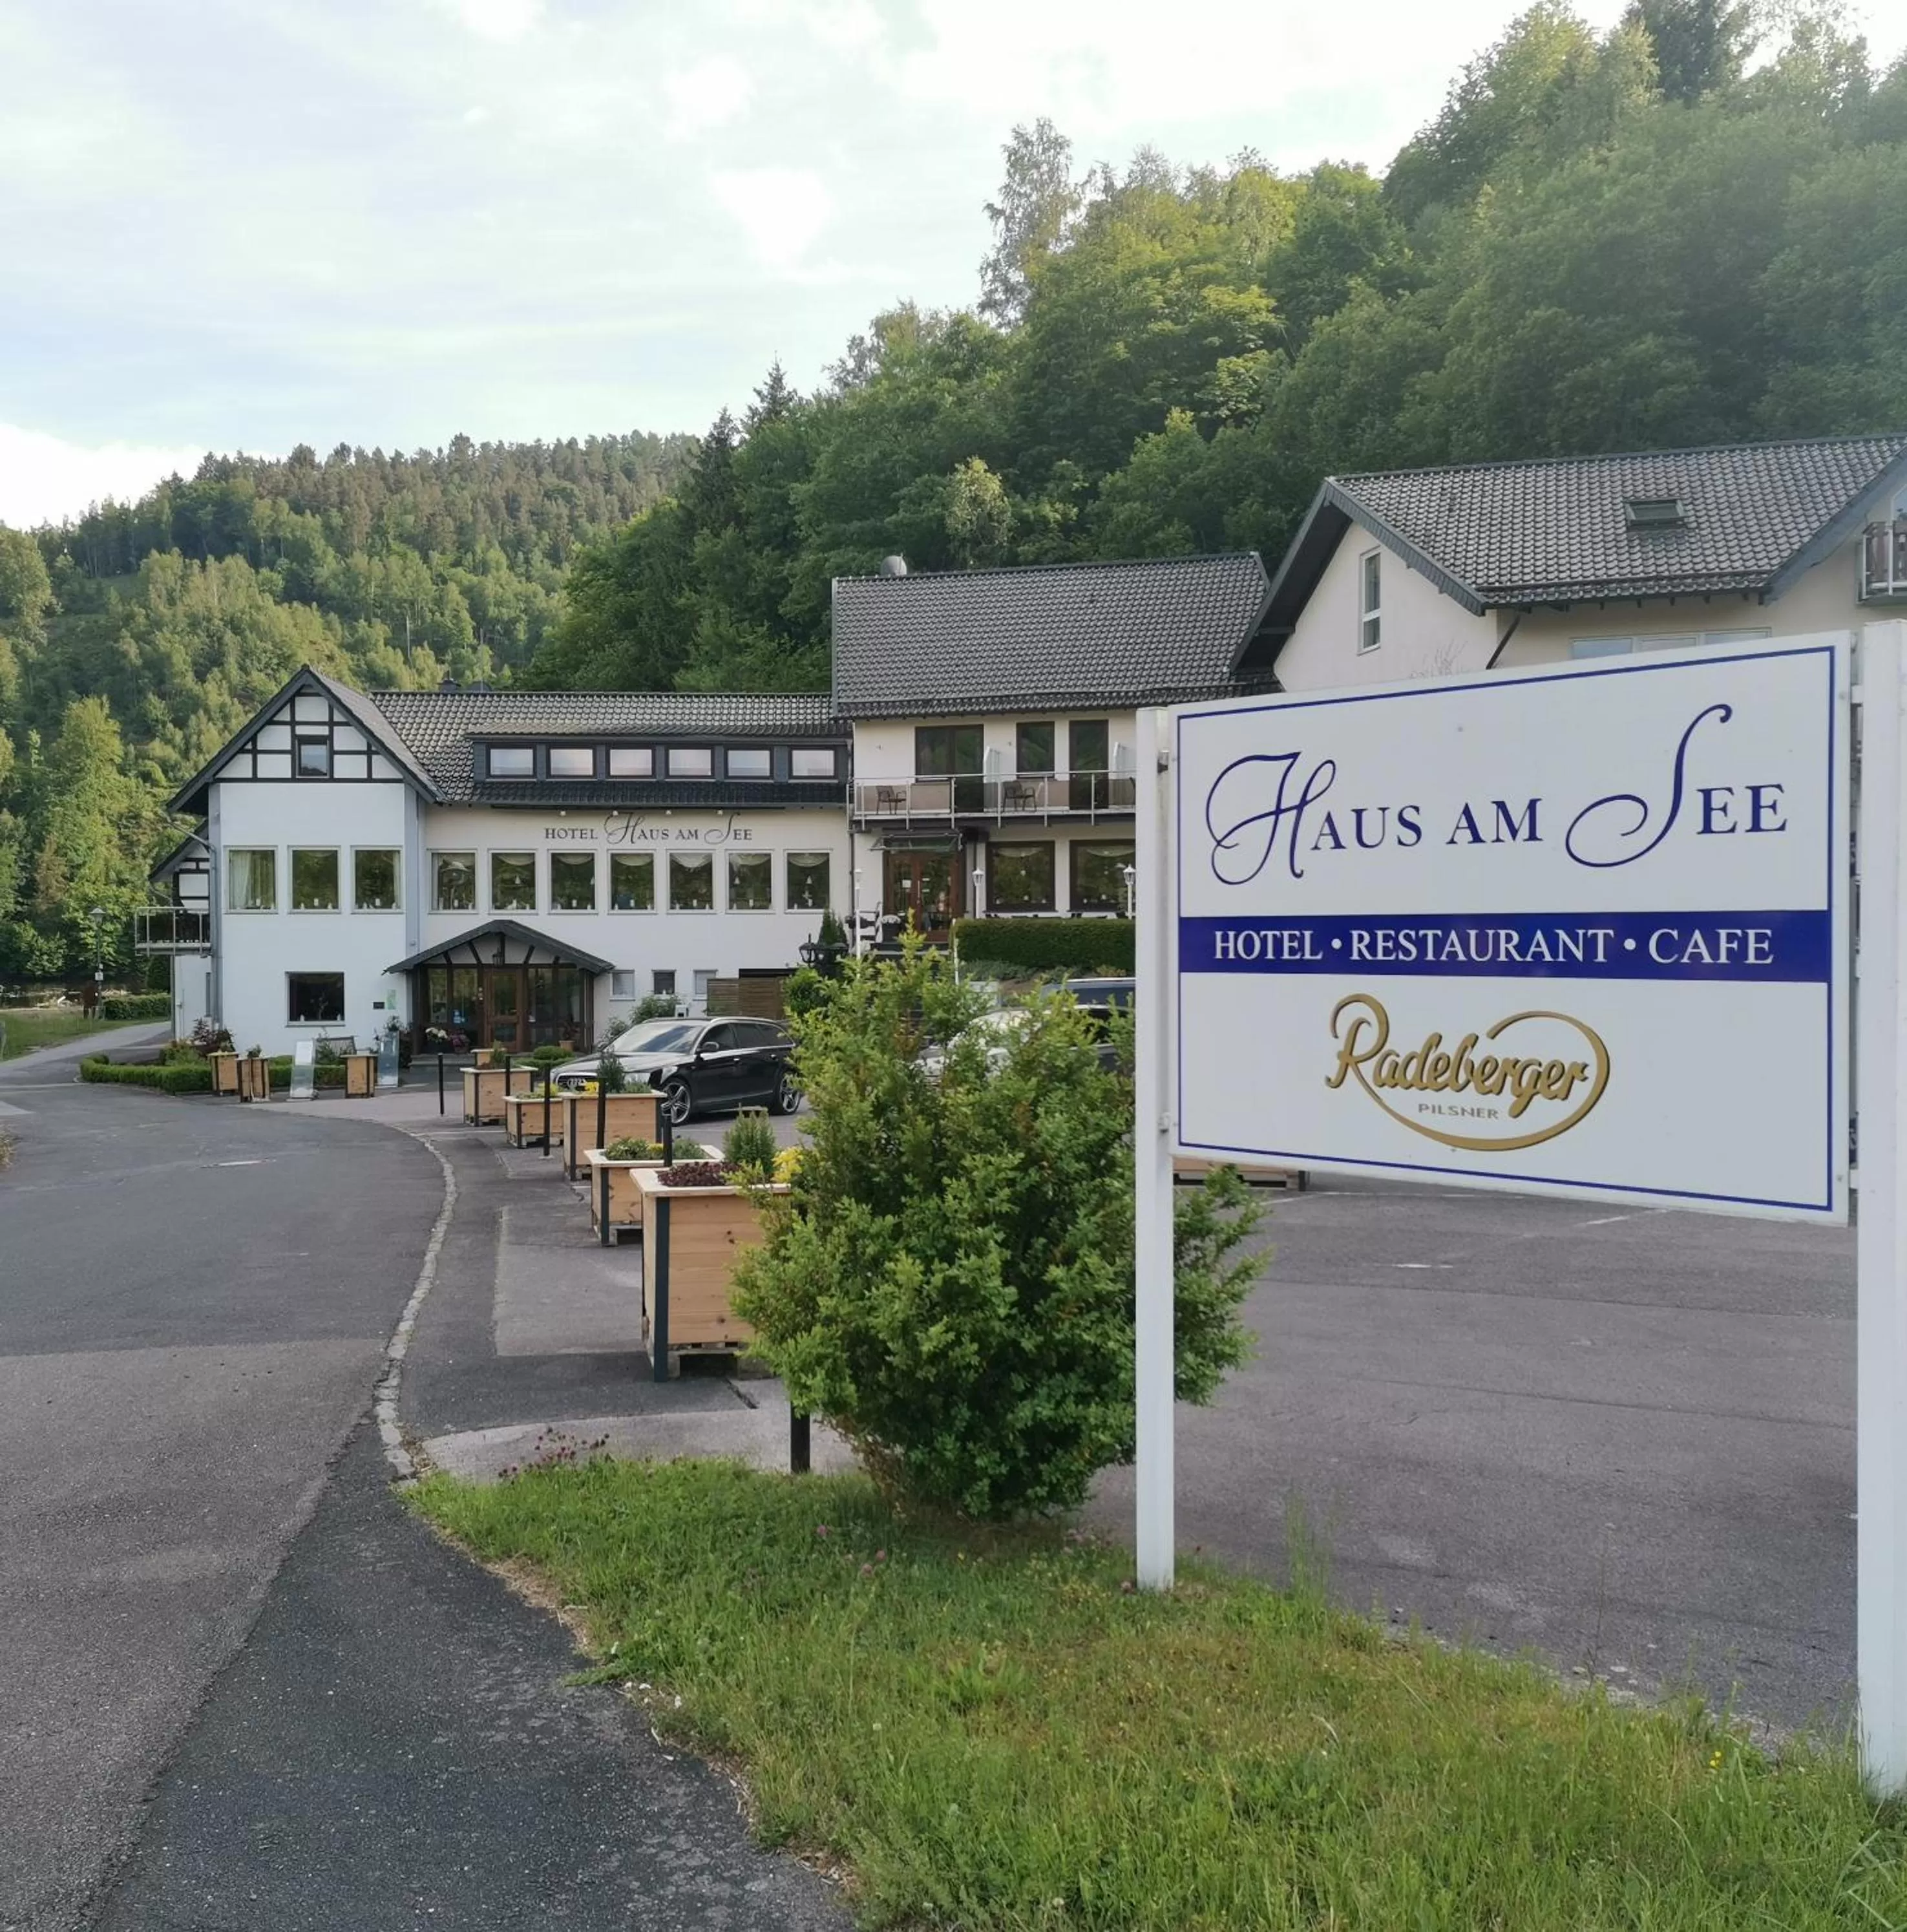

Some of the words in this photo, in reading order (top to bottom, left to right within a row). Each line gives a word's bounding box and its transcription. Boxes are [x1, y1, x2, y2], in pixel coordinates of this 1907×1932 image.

[545, 827, 598, 840] HOTEL
[675, 828, 699, 840] AM
[1205, 750, 1423, 886] HAUS
[1446, 798, 1544, 845] AM
[1214, 930, 1323, 961] HOTEL
[1350, 929, 1615, 963] RESTAURANT
[1649, 928, 1774, 964] CAFE
[1325, 993, 1588, 1119] Radeberger
[1417, 1103, 1499, 1120] PILSNER
